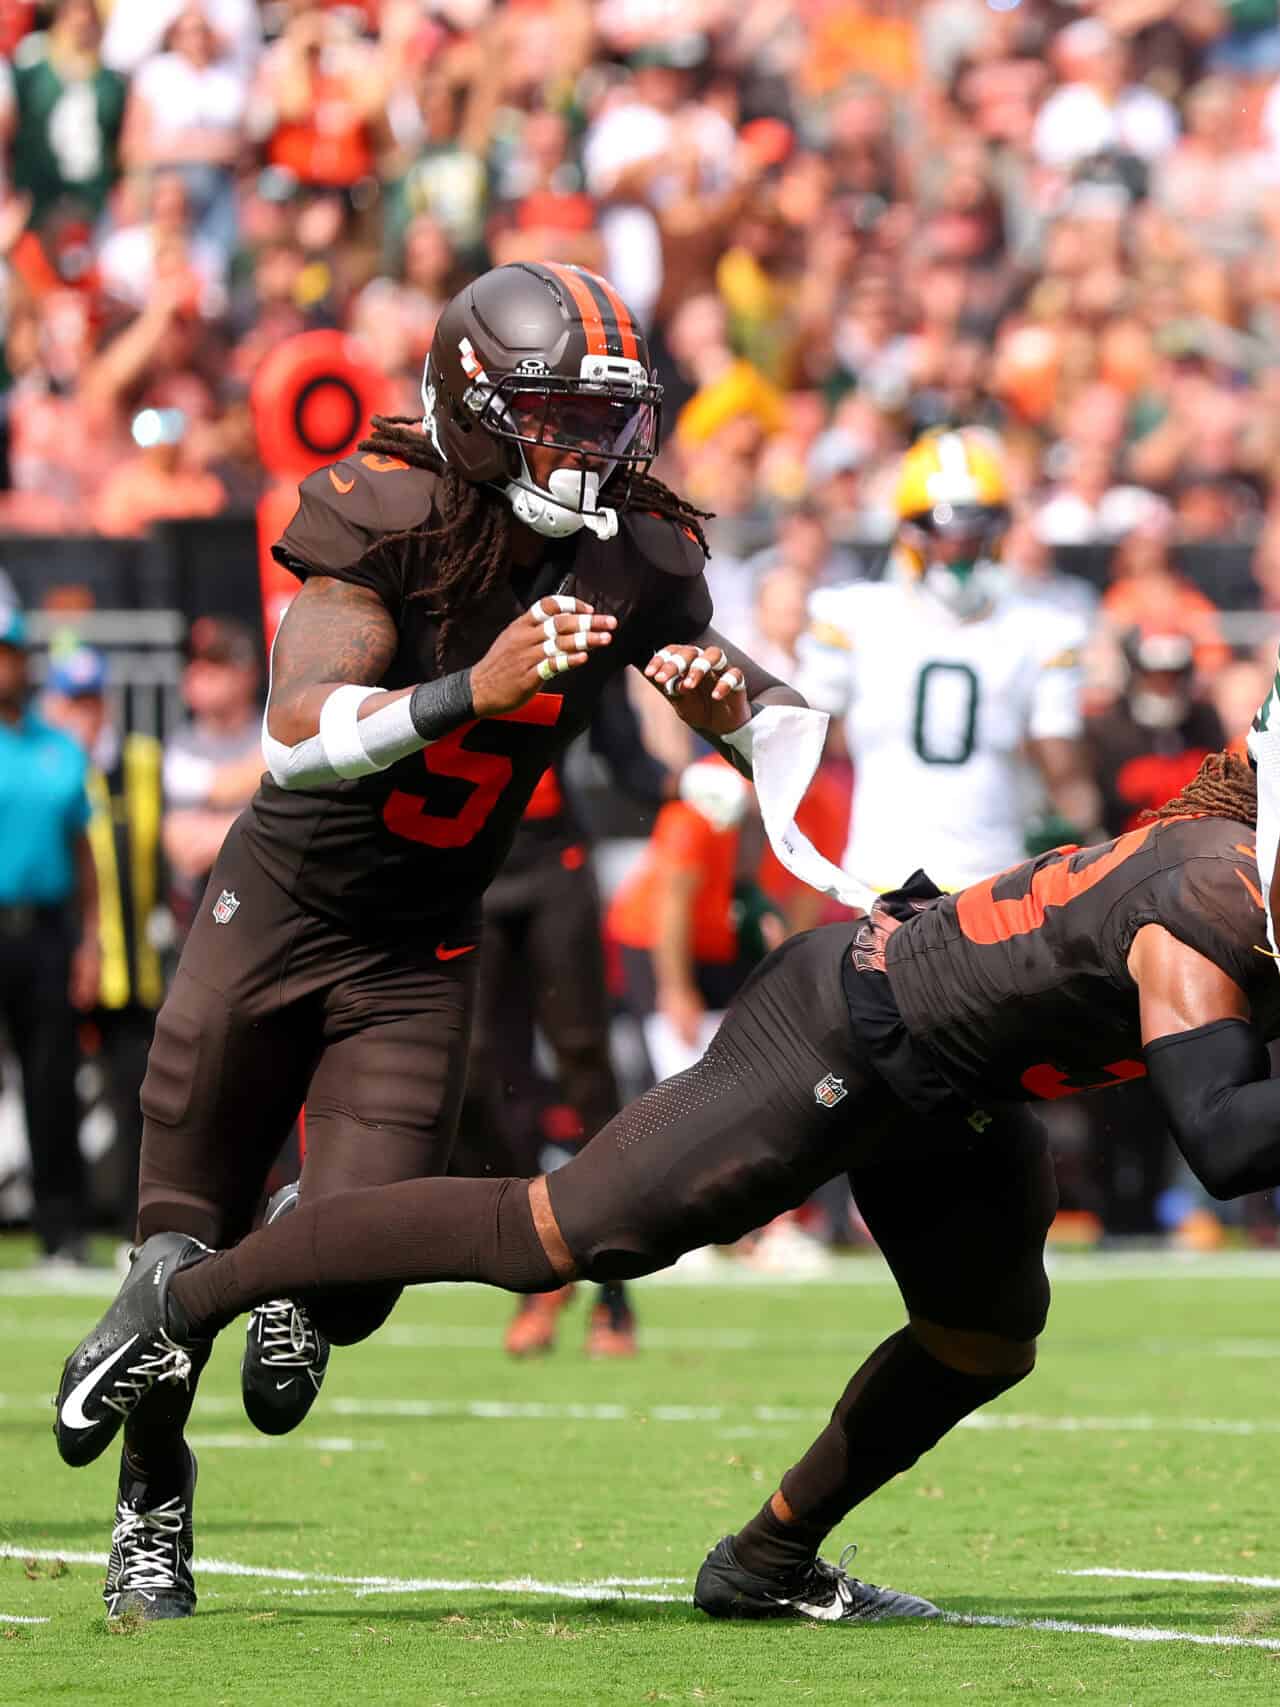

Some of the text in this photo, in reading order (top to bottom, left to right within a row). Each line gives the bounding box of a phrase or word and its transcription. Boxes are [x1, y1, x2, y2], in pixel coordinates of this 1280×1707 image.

[515, 367, 551, 375] OAKLEY
[914, 662, 978, 765] 0
[383, 692, 564, 848] 5
